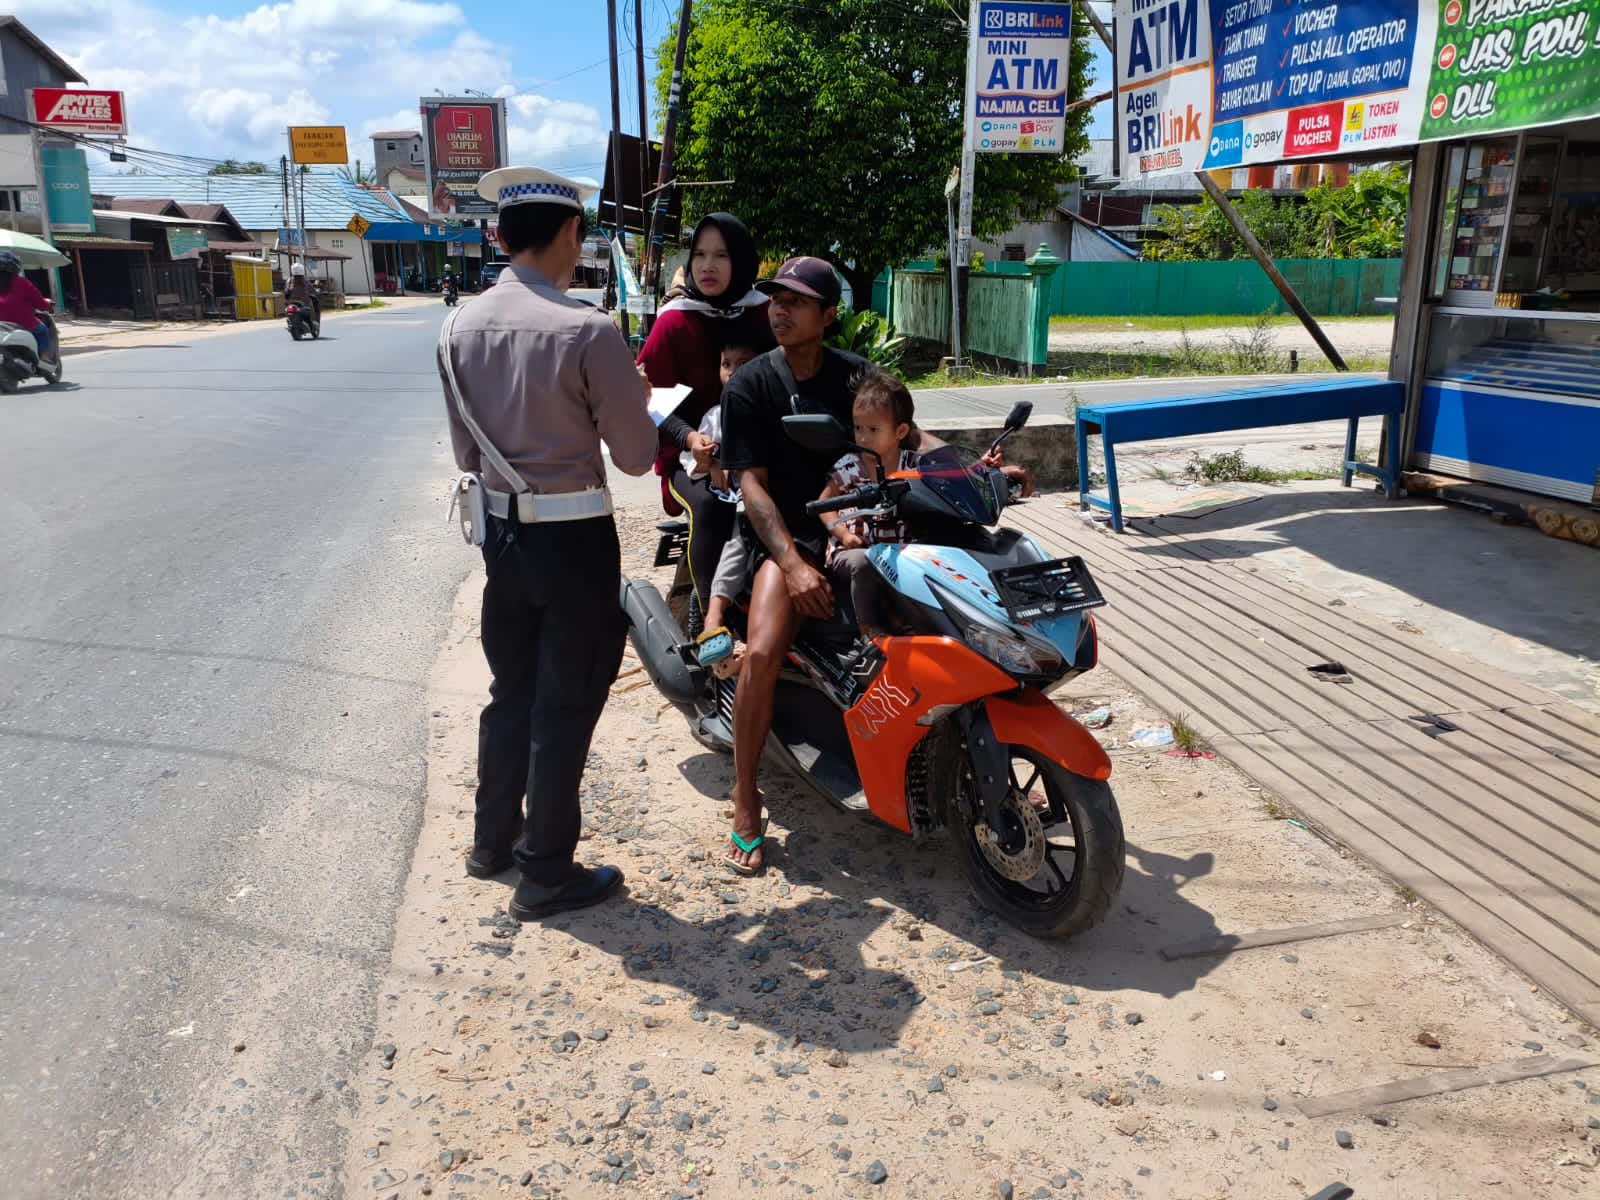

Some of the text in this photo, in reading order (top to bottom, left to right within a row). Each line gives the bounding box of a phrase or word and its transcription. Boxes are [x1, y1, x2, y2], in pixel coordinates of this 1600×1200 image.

[1005, 11, 1064, 29] BRILink
[1225, 2, 1248, 28] SETOR
[1295, 5, 1337, 36] VOCHER
[987, 40, 1027, 55] MINI
[1127, 0, 1198, 78] ATM
[1224, 24, 1267, 56] TARIK TUNAI
[1290, 19, 1407, 67] PULSA ALL OPERATOR
[1457, 28, 1515, 75] JAS,
[986, 58, 1058, 90] ATM
[1223, 56, 1257, 83] TRANSFER
[1288, 73, 1309, 97] TOP
[1308, 69, 1323, 93] UP
[1352, 63, 1382, 85] GOPAY,
[1126, 92, 1158, 117] Agen
[1221, 80, 1273, 111] BAYAR CICILAN
[1450, 79, 1497, 123] DLL
[70, 107, 113, 119] ALKES
[980, 99, 1060, 114] NAJMA CELL
[1369, 100, 1400, 118] TOKEN
[1127, 104, 1202, 154] BRILink
[1298, 115, 1330, 131] PULSA
[1363, 123, 1399, 141] LISTRIK
[450, 141, 479, 150] SUPER
[991, 139, 1017, 148] gopay
[1033, 138, 1056, 147] PLN
[1253, 130, 1283, 148] gopay
[1293, 131, 1332, 147] VOCHER
[1343, 133, 1362, 143] PLN
[448, 156, 482, 165] KRETEK
